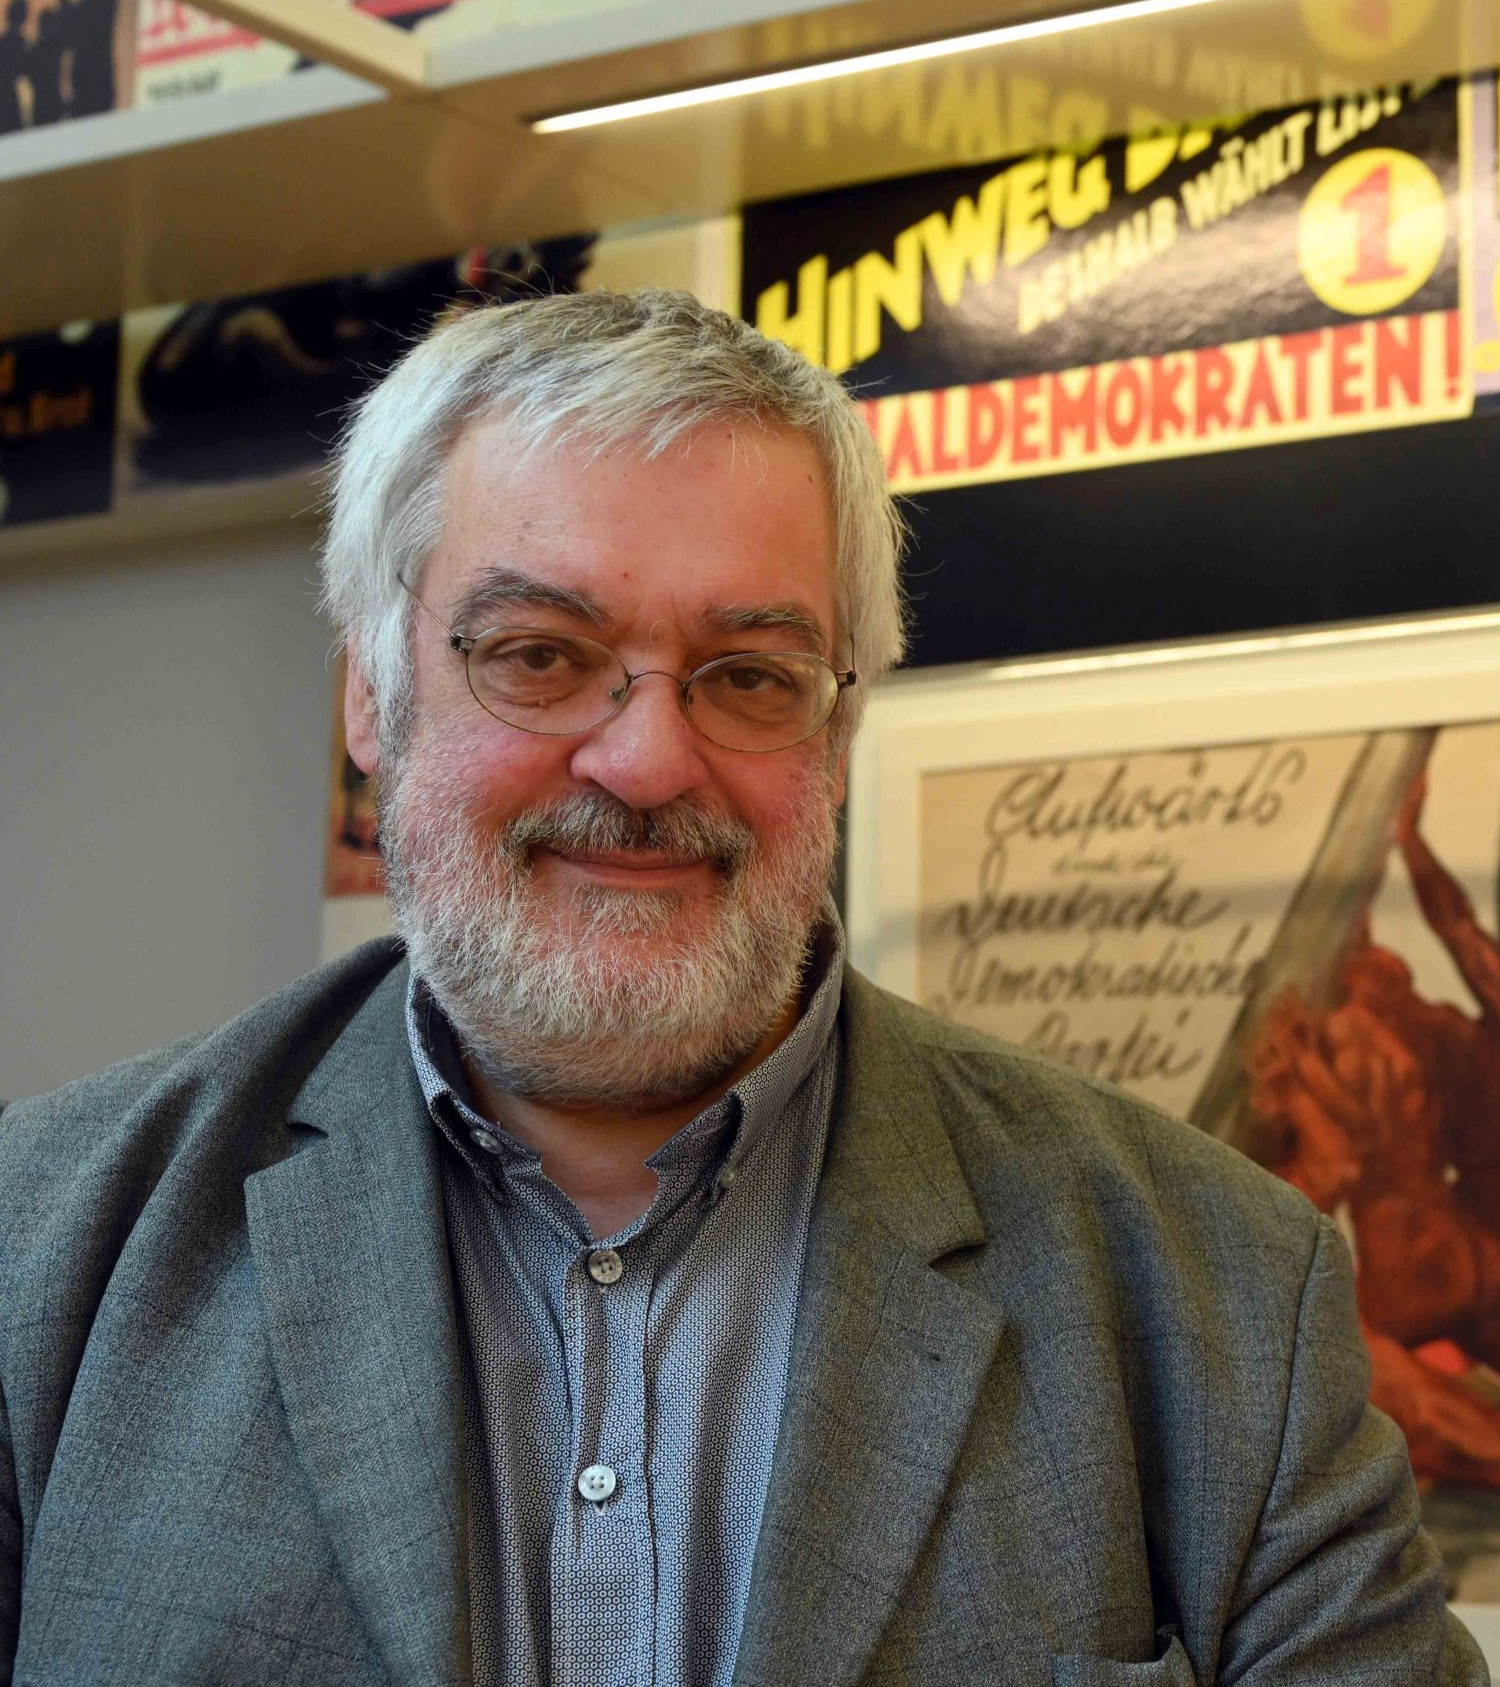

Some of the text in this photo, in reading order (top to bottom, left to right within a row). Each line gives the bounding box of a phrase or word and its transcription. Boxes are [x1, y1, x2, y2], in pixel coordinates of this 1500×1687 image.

[757, 150, 1112, 373] HINWEG
[1018, 196, 1178, 334] DESHALB
[1181, 112, 1312, 229] WÄHLT
[1341, 162, 1405, 286] 1
